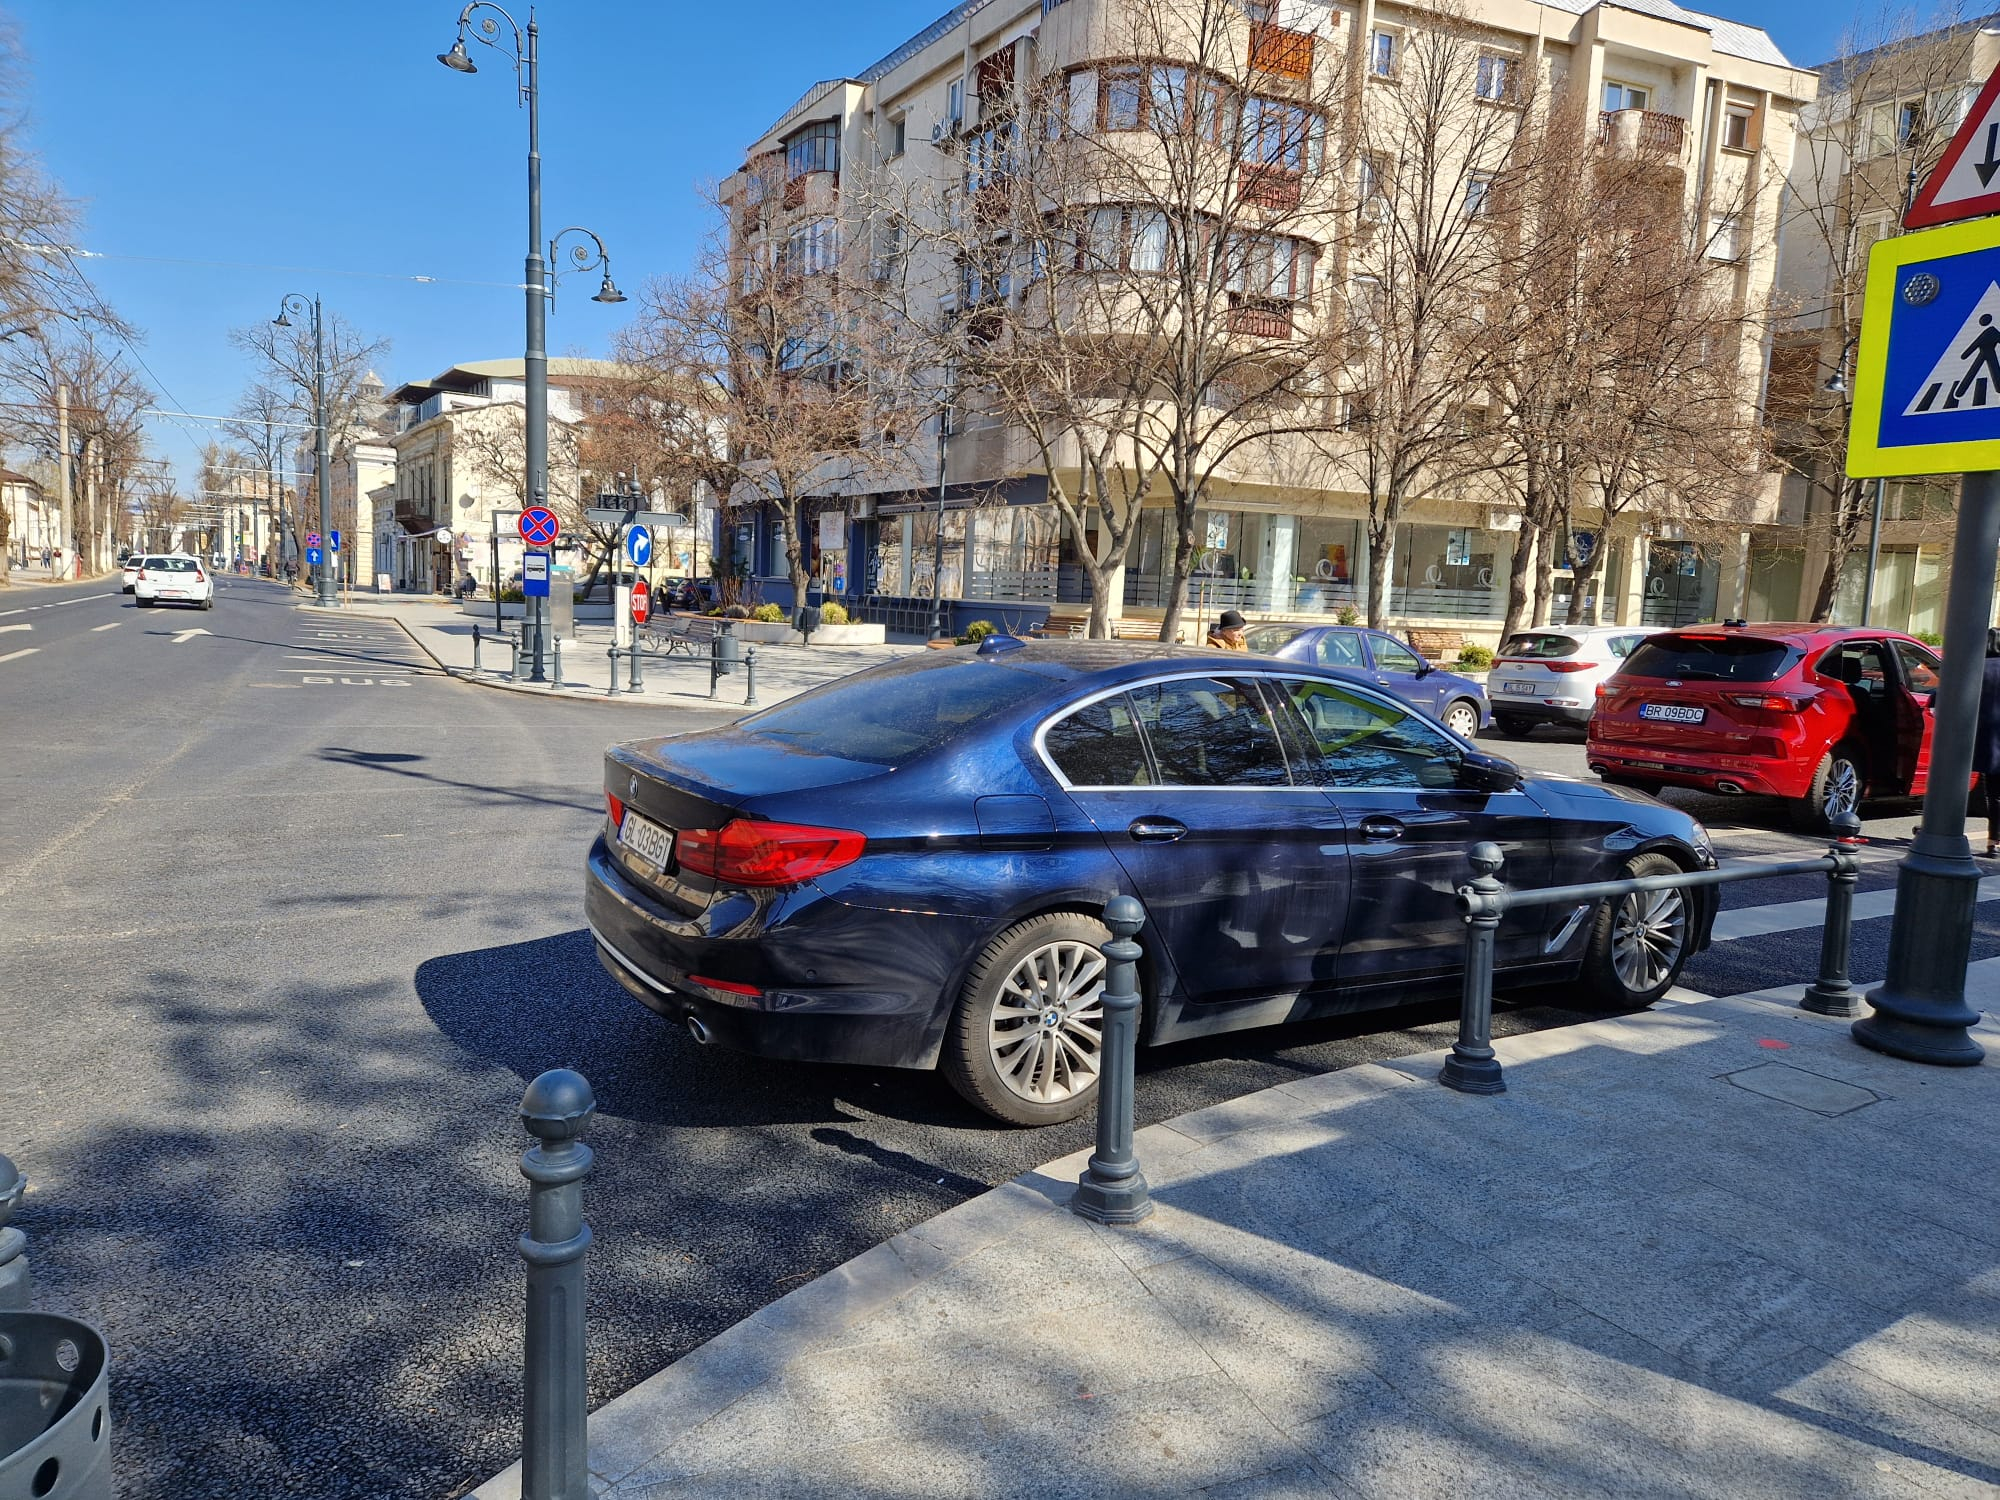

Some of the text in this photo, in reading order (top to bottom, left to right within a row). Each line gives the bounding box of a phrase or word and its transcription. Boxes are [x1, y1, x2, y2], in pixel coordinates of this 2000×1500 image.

[631, 594, 647, 610] STOP
[302, 676, 412, 687] BUS
[1646, 705, 1703, 720] BR 09BDC
[624, 815, 671, 863] GL 03BGT
